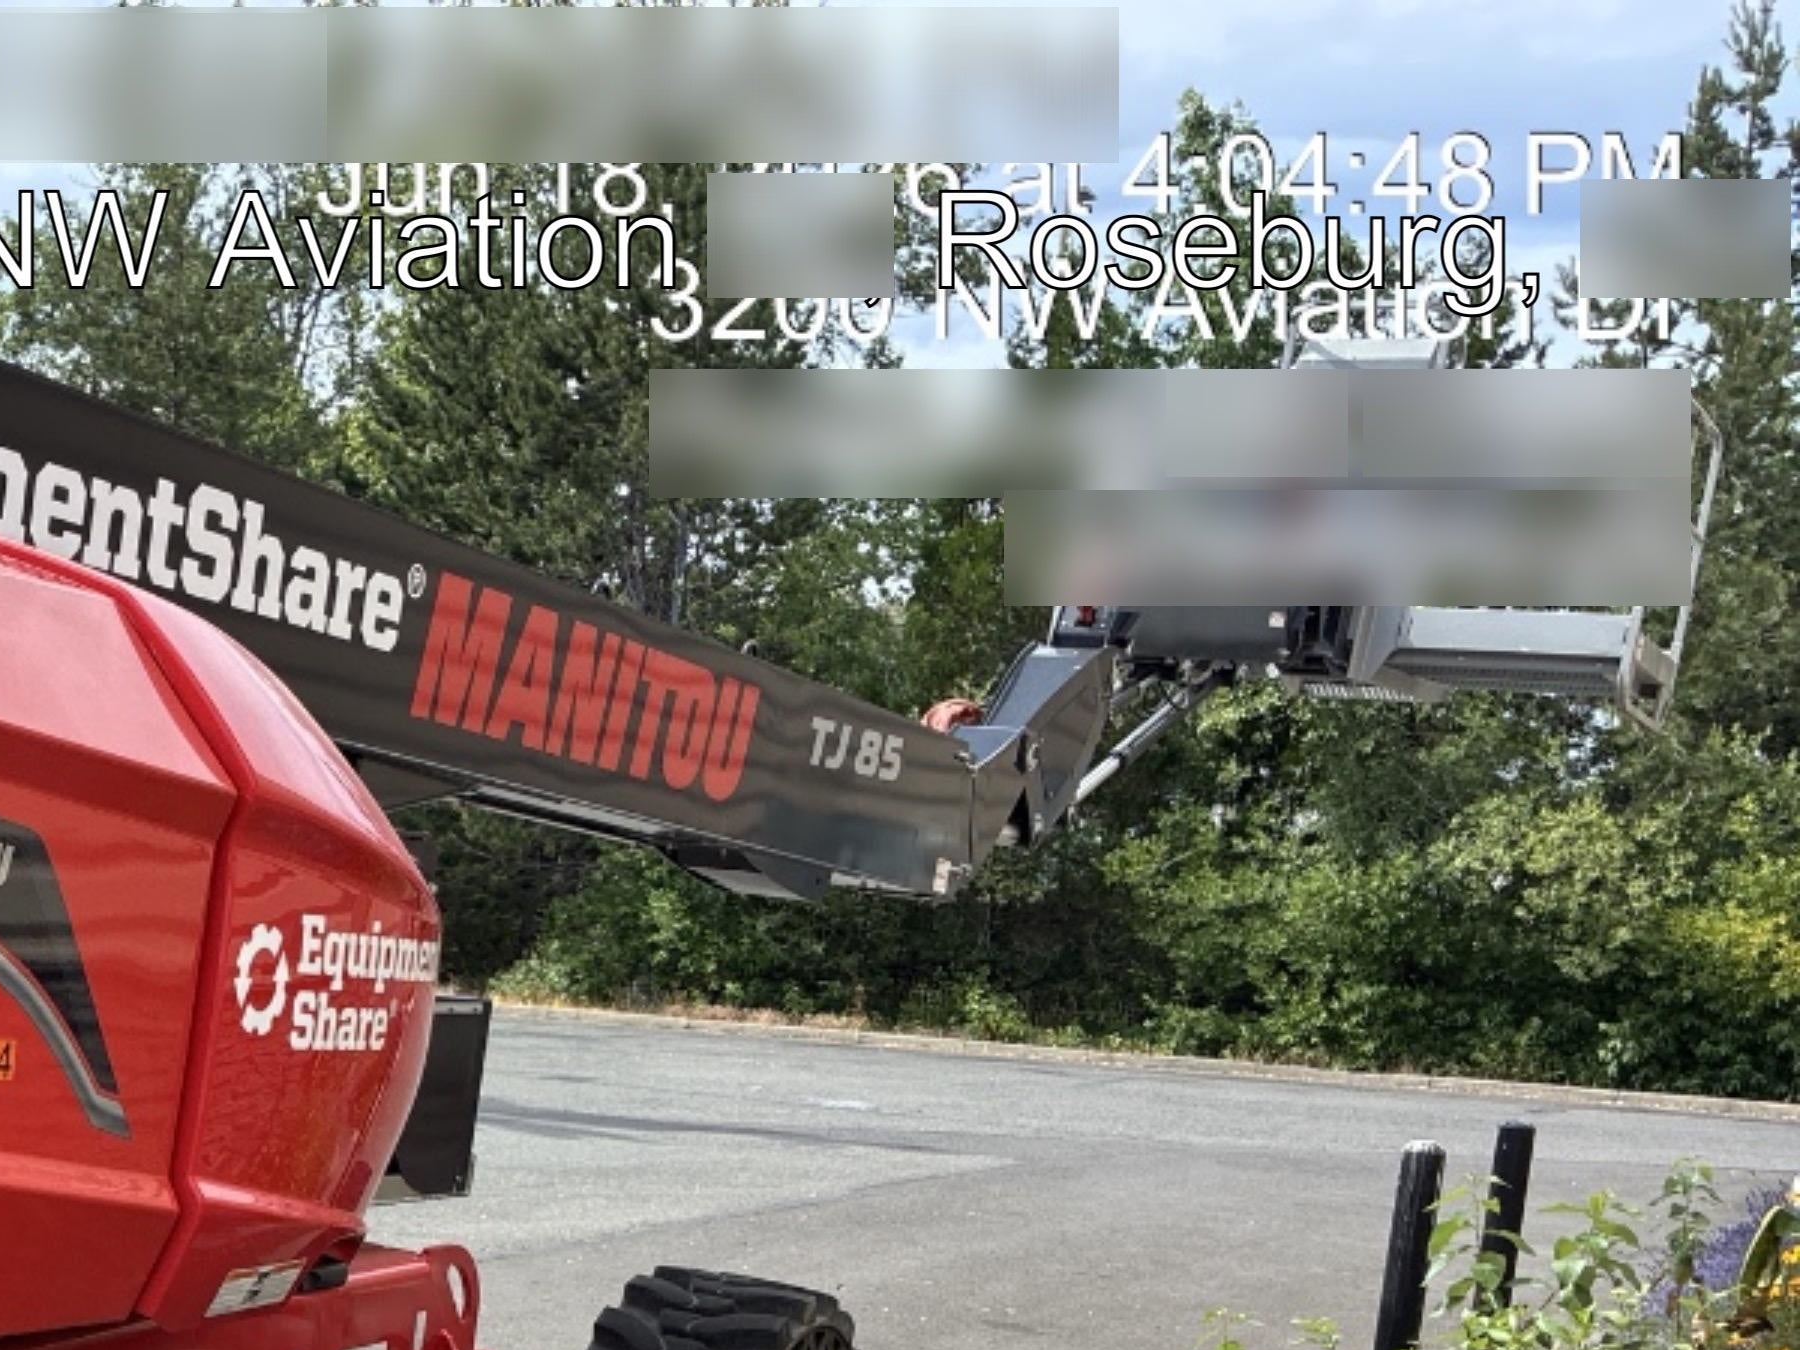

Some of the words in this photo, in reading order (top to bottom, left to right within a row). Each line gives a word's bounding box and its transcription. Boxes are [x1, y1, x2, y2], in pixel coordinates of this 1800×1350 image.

[409, 570, 761, 801] MANITOU
[809, 716, 857, 771] TJ
[858, 730, 905, 782] 85
